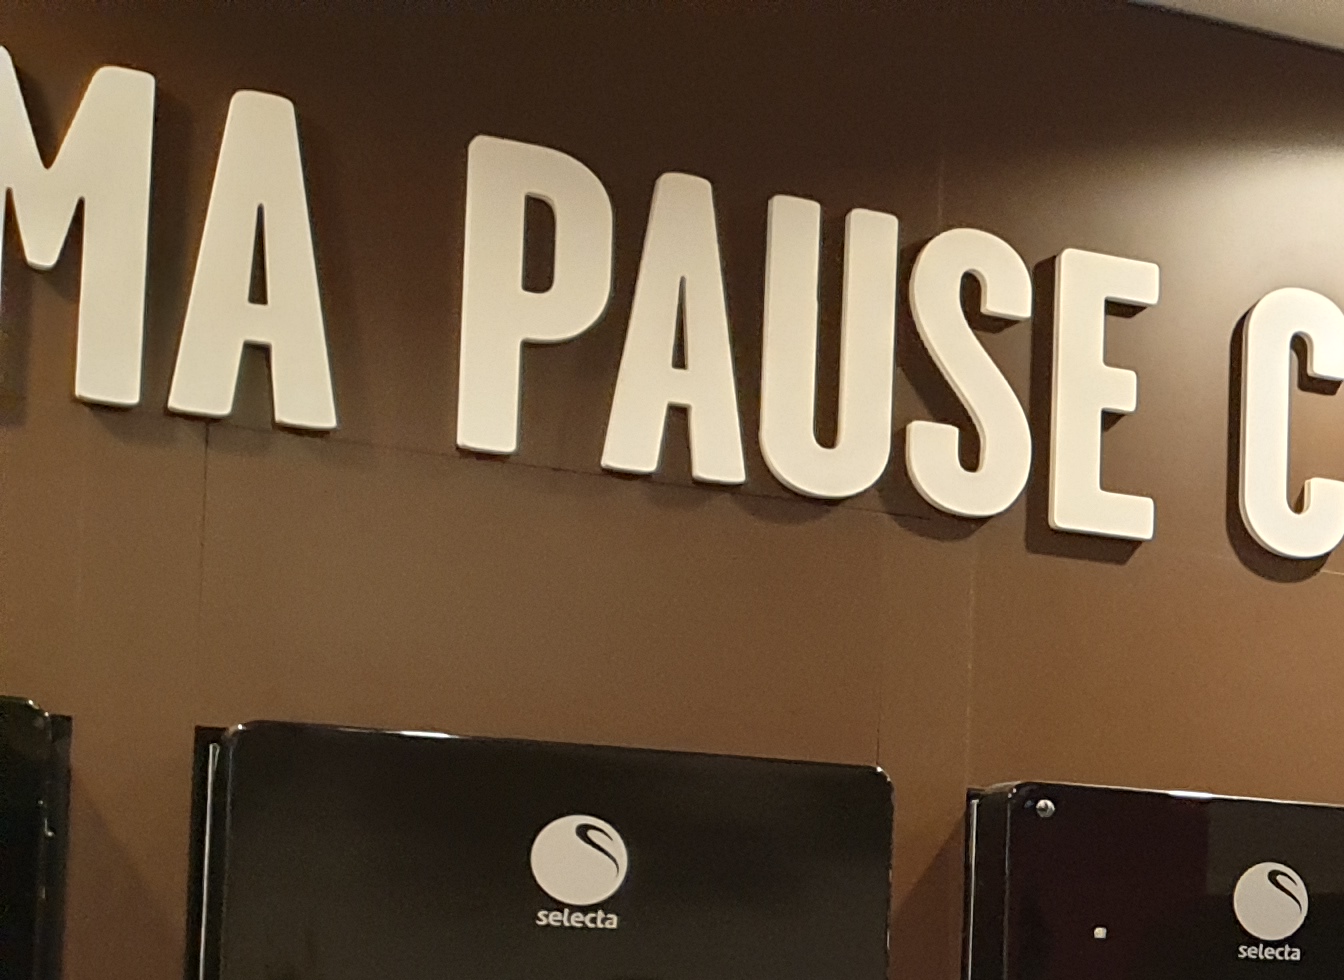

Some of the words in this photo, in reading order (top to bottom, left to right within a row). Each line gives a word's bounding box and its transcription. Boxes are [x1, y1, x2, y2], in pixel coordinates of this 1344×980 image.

[0, 45, 338, 430] MA
[457, 135, 1159, 540] PAUSE
[535, 908, 618, 930] selecta
[1237, 943, 1301, 961] selecta
